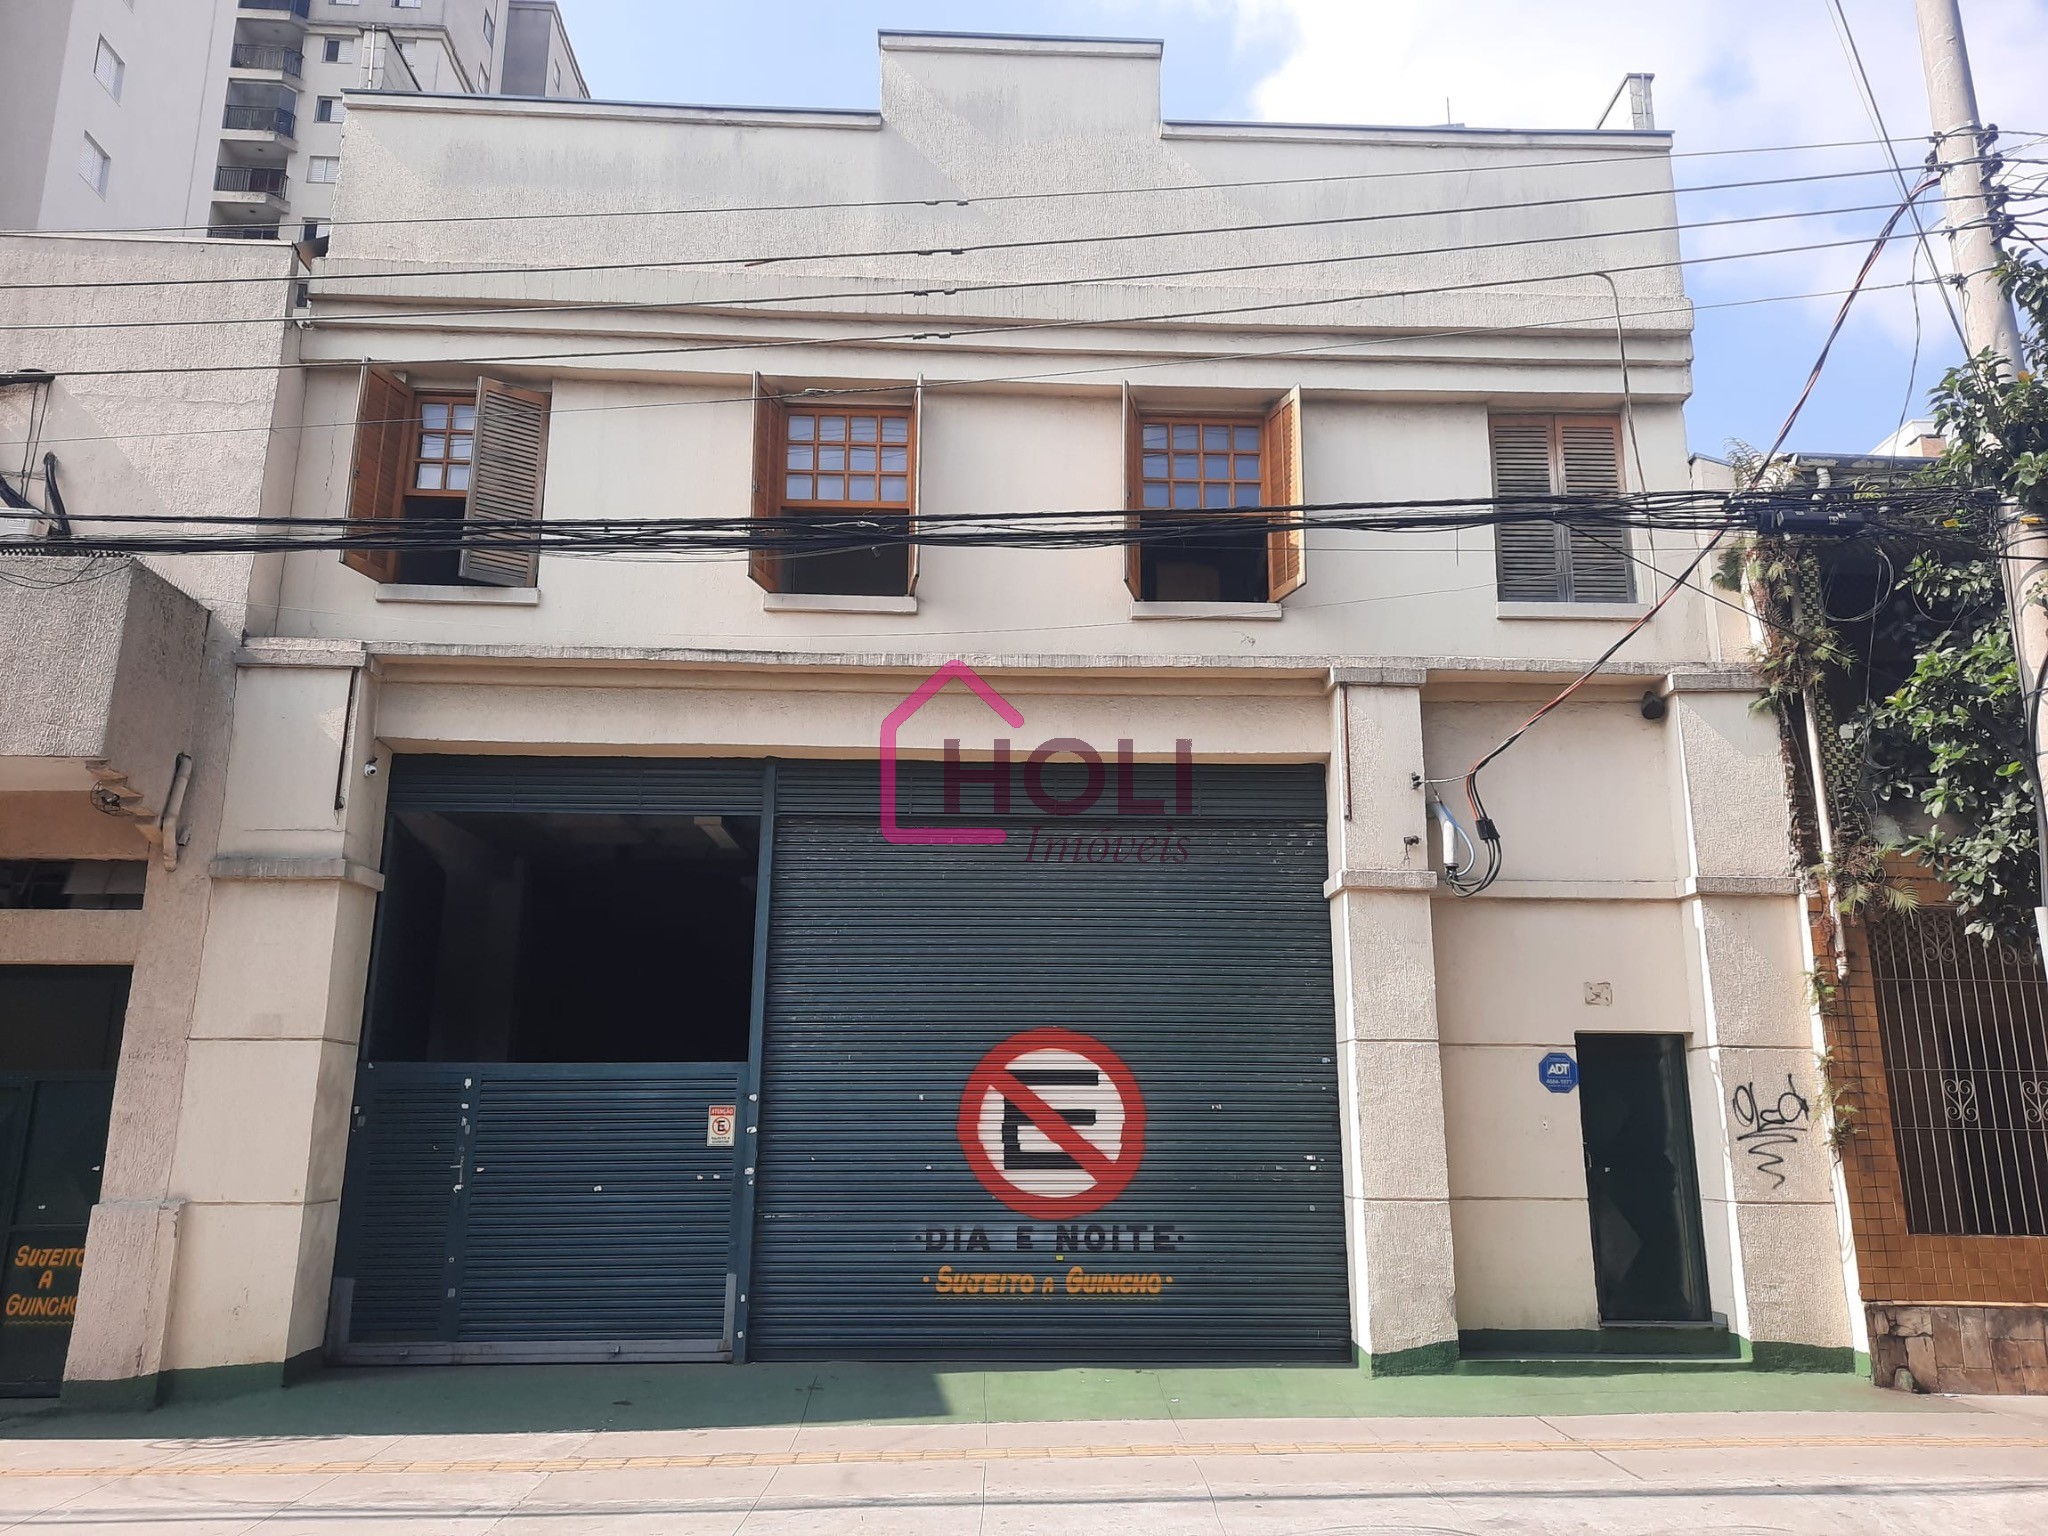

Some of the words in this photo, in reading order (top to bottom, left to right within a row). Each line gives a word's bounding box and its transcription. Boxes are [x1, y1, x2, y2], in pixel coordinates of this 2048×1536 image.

[1548, 1063, 1570, 1075] ADT
[925, 1227, 991, 1251] DIA
[1016, 1225, 1034, 1250] E
[1055, 1224, 1176, 1251] NOITE
[37, 1270, 53, 1289] A
[935, 1265, 1036, 1294] SUJEITO
[1065, 1265, 1163, 1294] GUINCHO
